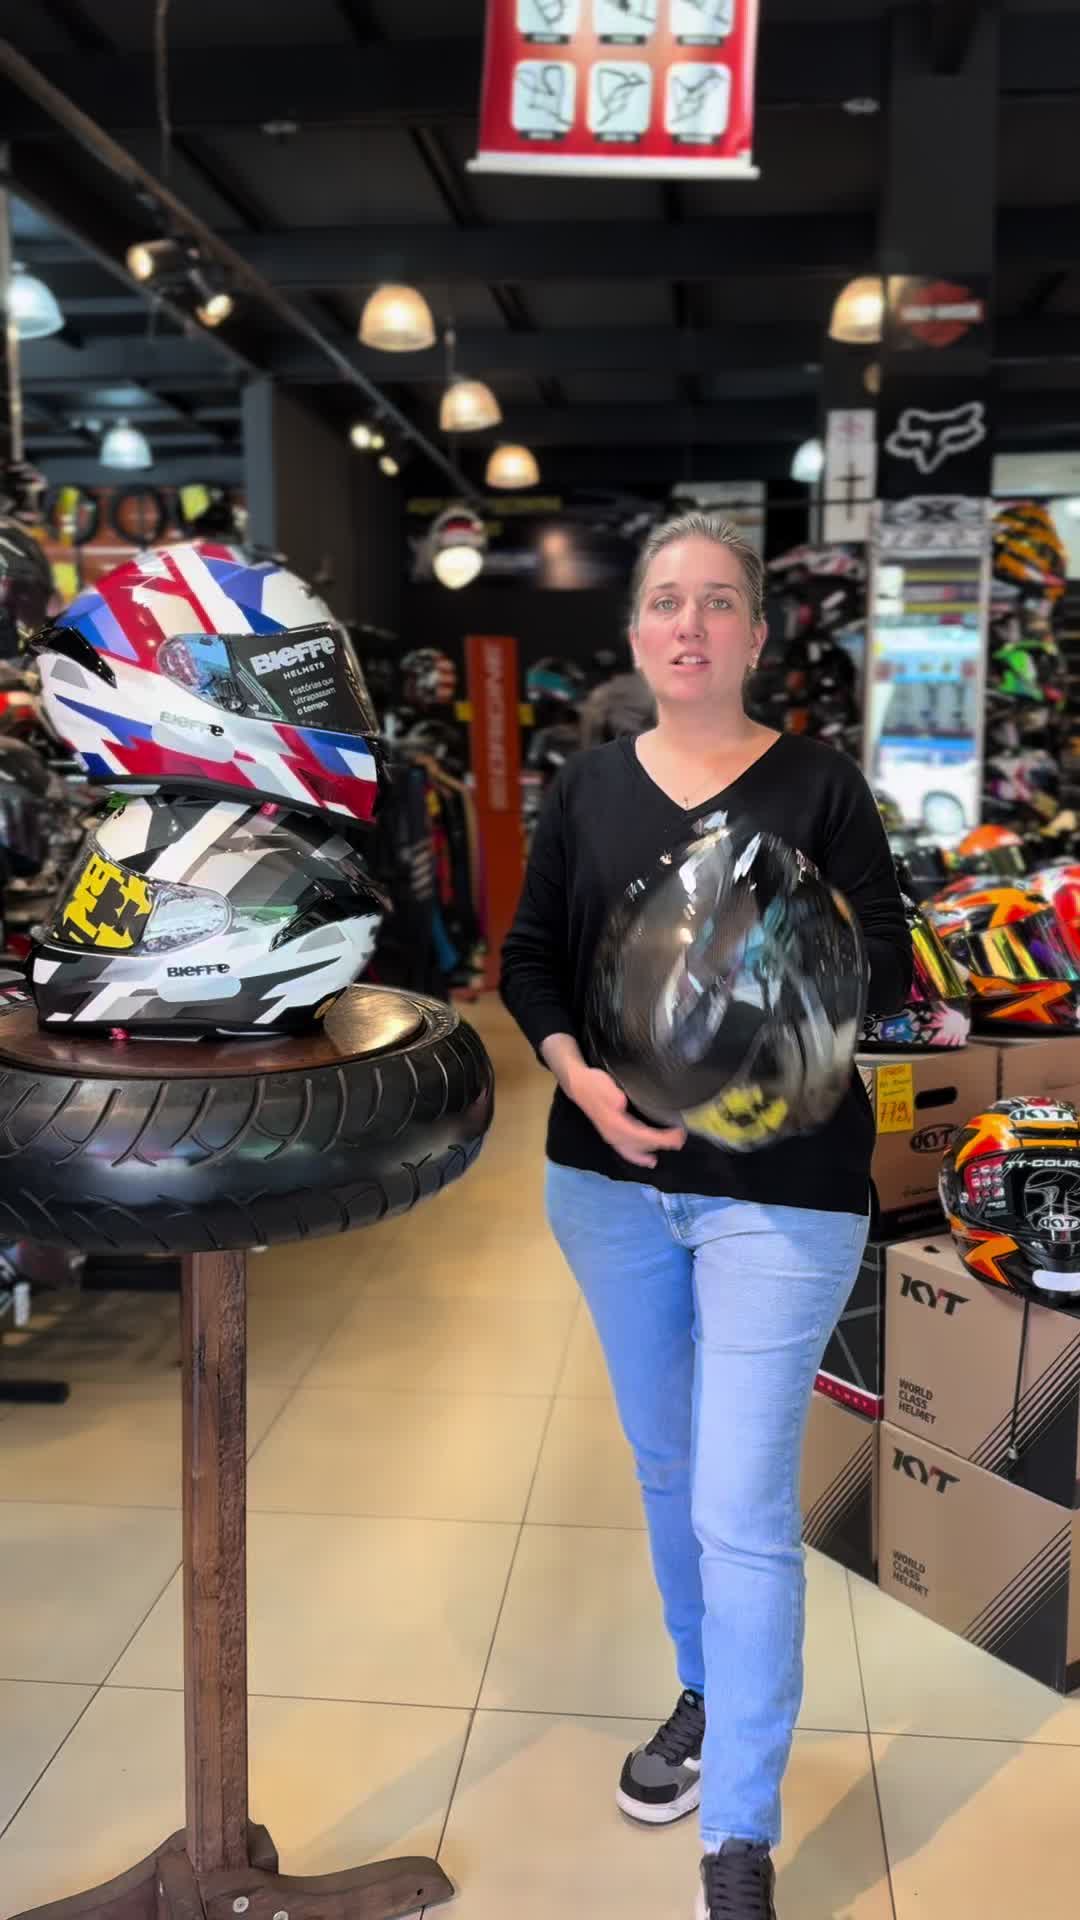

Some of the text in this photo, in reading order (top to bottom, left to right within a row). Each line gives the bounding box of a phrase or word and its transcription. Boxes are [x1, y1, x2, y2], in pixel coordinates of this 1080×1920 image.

[282, 661, 325, 680] HELMETS
[289, 677, 334, 696] Histórias que
[293, 687, 336, 706] ultrapassam
[296, 708, 304, 716] o
[1010, 1109, 1072, 1121] KYT
[1006, 1159, 1080, 1168] TT-COUR
[900, 1273, 971, 1316] KYT
[899, 1379, 933, 1400] WORLD
[899, 1390, 928, 1409] CLASS
[899, 1401, 936, 1424] HELMET
[893, 1448, 960, 1494] KYT
[893, 1551, 925, 1574] WORLD
[893, 1561, 920, 1581] CLASS
[893, 1571, 928, 1597] HELMET
